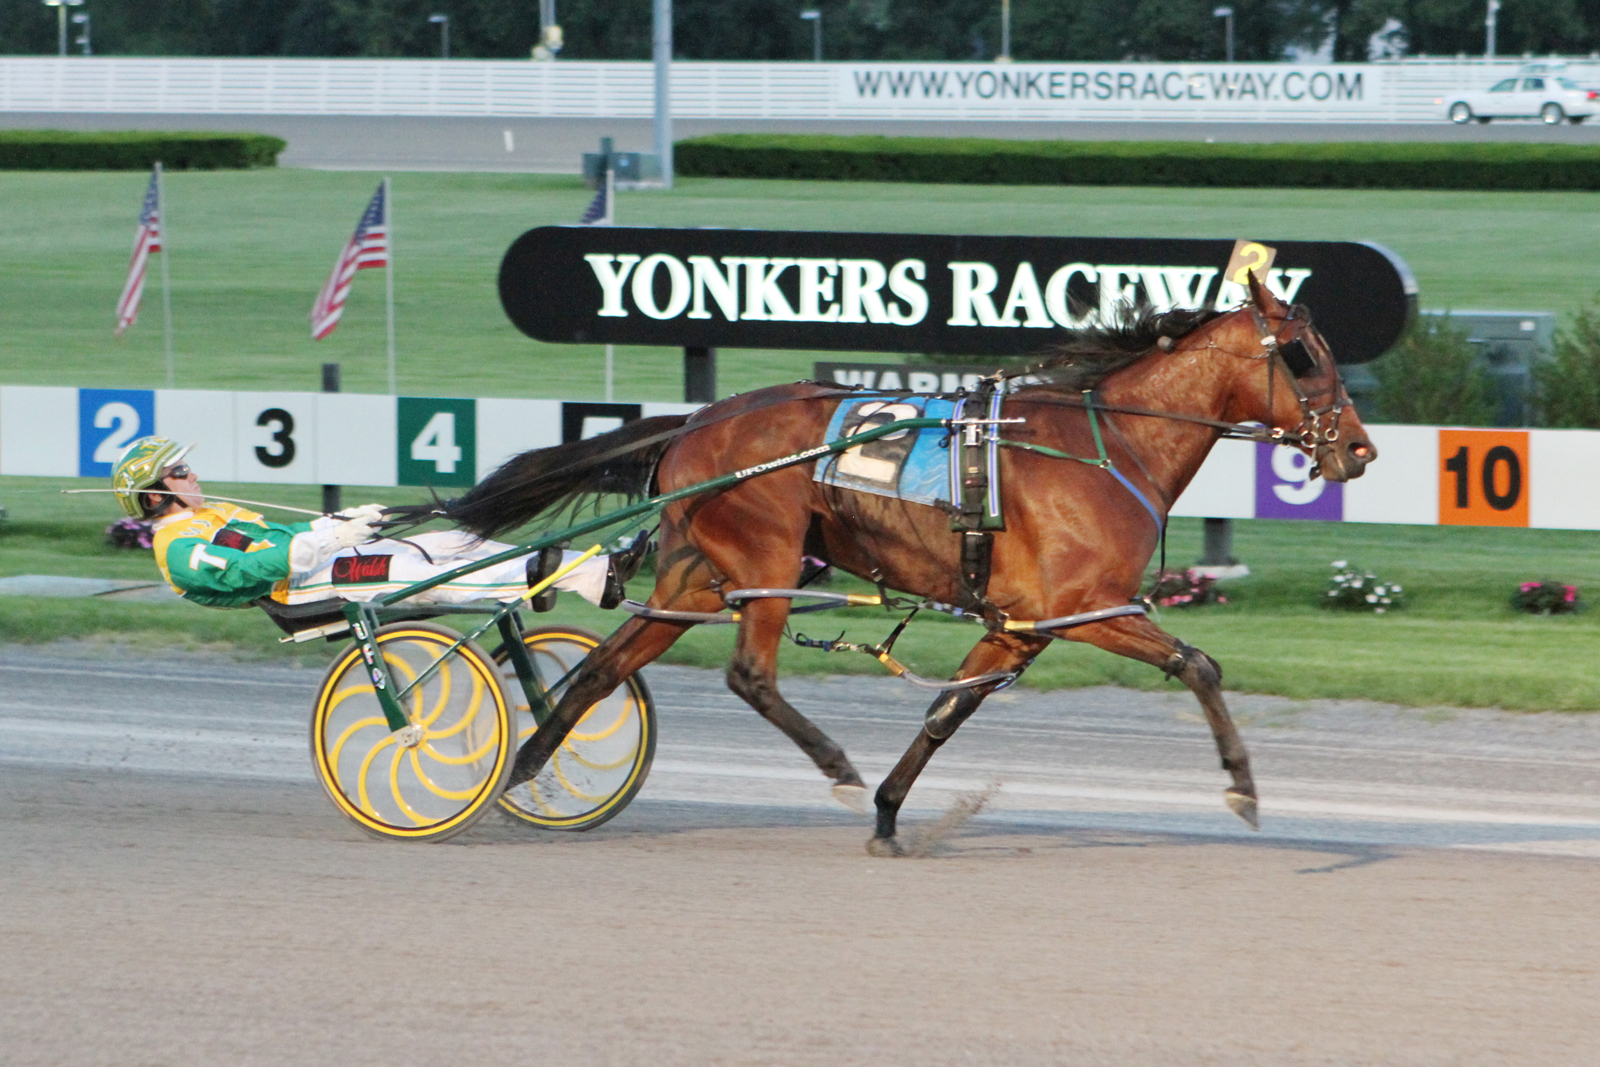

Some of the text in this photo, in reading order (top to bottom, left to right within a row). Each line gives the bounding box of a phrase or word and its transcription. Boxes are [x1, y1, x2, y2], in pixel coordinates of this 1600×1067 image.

[853, 70, 1364, 101] WWW.YONKERSRACEWAY.COM
[583, 252, 930, 327] YONKERS
[1233, 243, 1268, 285] 2
[92, 402, 141, 465] 2
[254, 407, 296, 468] 3
[410, 411, 463, 474] 4
[836, 401, 919, 483] 2
[1271, 439, 1326, 506] 9
[1445, 445, 1522, 512] 10
